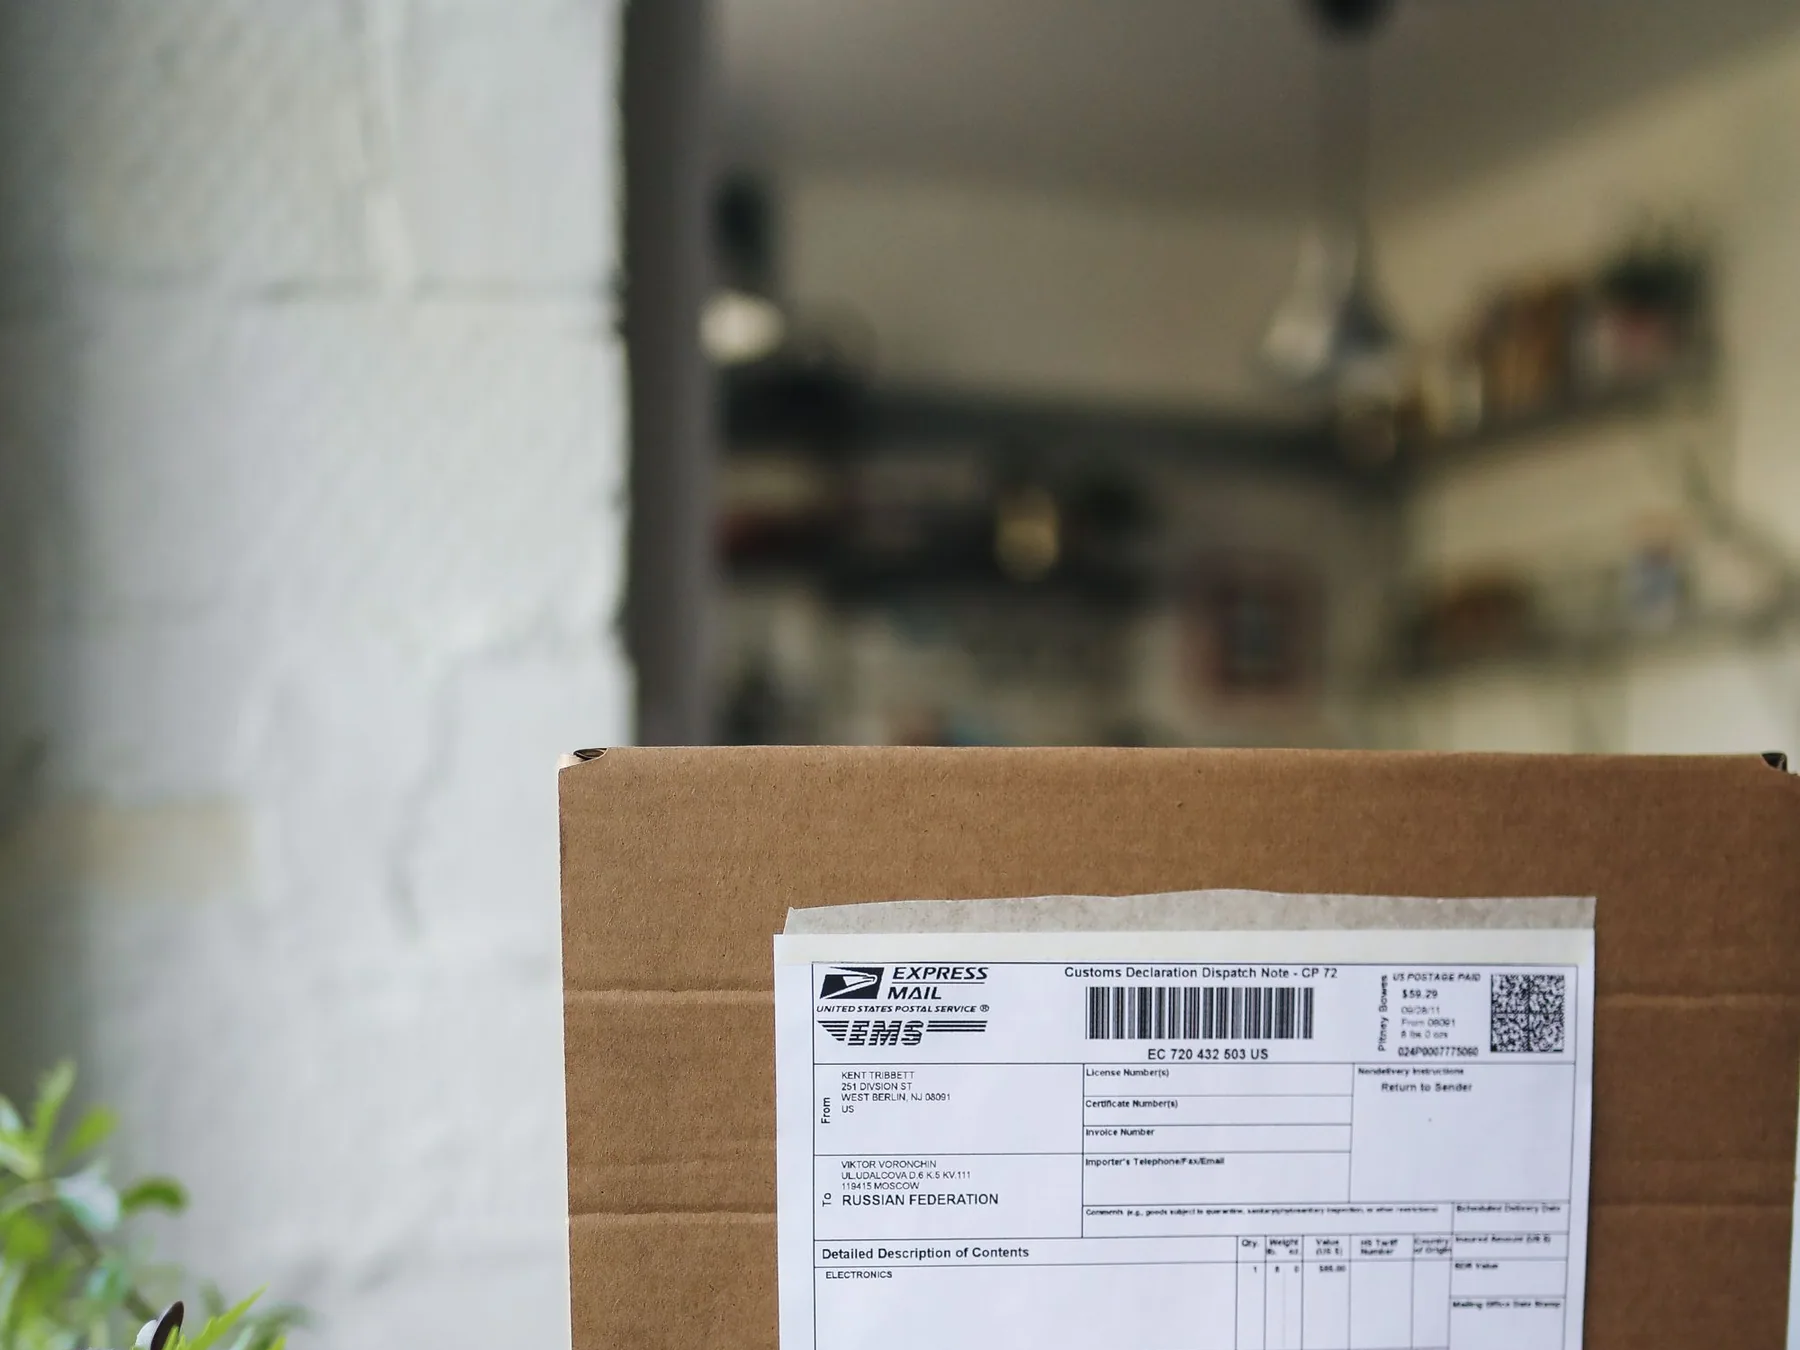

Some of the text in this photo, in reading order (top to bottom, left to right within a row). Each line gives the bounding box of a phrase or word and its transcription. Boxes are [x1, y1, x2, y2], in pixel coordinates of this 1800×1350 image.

[892, 966, 989, 980] EXPRESS
[1065, 967, 1338, 980] Customs Declaration Dispatch Note CP 72
[1393, 973, 1481, 982] US POSTAGE PAID
[887, 986, 942, 1000] MAIL
[1402, 989, 1438, 999] $59.29
[816, 1005, 976, 1013] UNITED STATES POSTAL SERVICE
[848, 1020, 924, 1046] EMS
[1147, 1049, 1268, 1060] EC 720 432 503 US
[841, 1071, 915, 1080] KENT TRIBBETT
[1086, 1069, 1169, 1078] License Number(s)
[841, 1082, 912, 1091] 251 DIVSION ST
[1381, 1082, 1473, 1092] Return to Sender
[841, 1092, 950, 1103] WEST BERLIN, NJ 08091
[841, 1104, 854, 1113] US
[1085, 1099, 1178, 1110] Certificate Number(s)
[821, 1097, 831, 1124] From
[1086, 1128, 1155, 1136] Invoice Number
[841, 1160, 936, 1169] VIKTOR VORONCHIN
[842, 1181, 920, 1190] 119415 MOSCOW
[822, 1192, 832, 1207] To
[842, 1193, 999, 1206] RUSSIAN FEDERATION
[822, 1247, 1029, 1262] Detailed Description of Contents
[825, 1271, 893, 1279] ELECTRONICS
